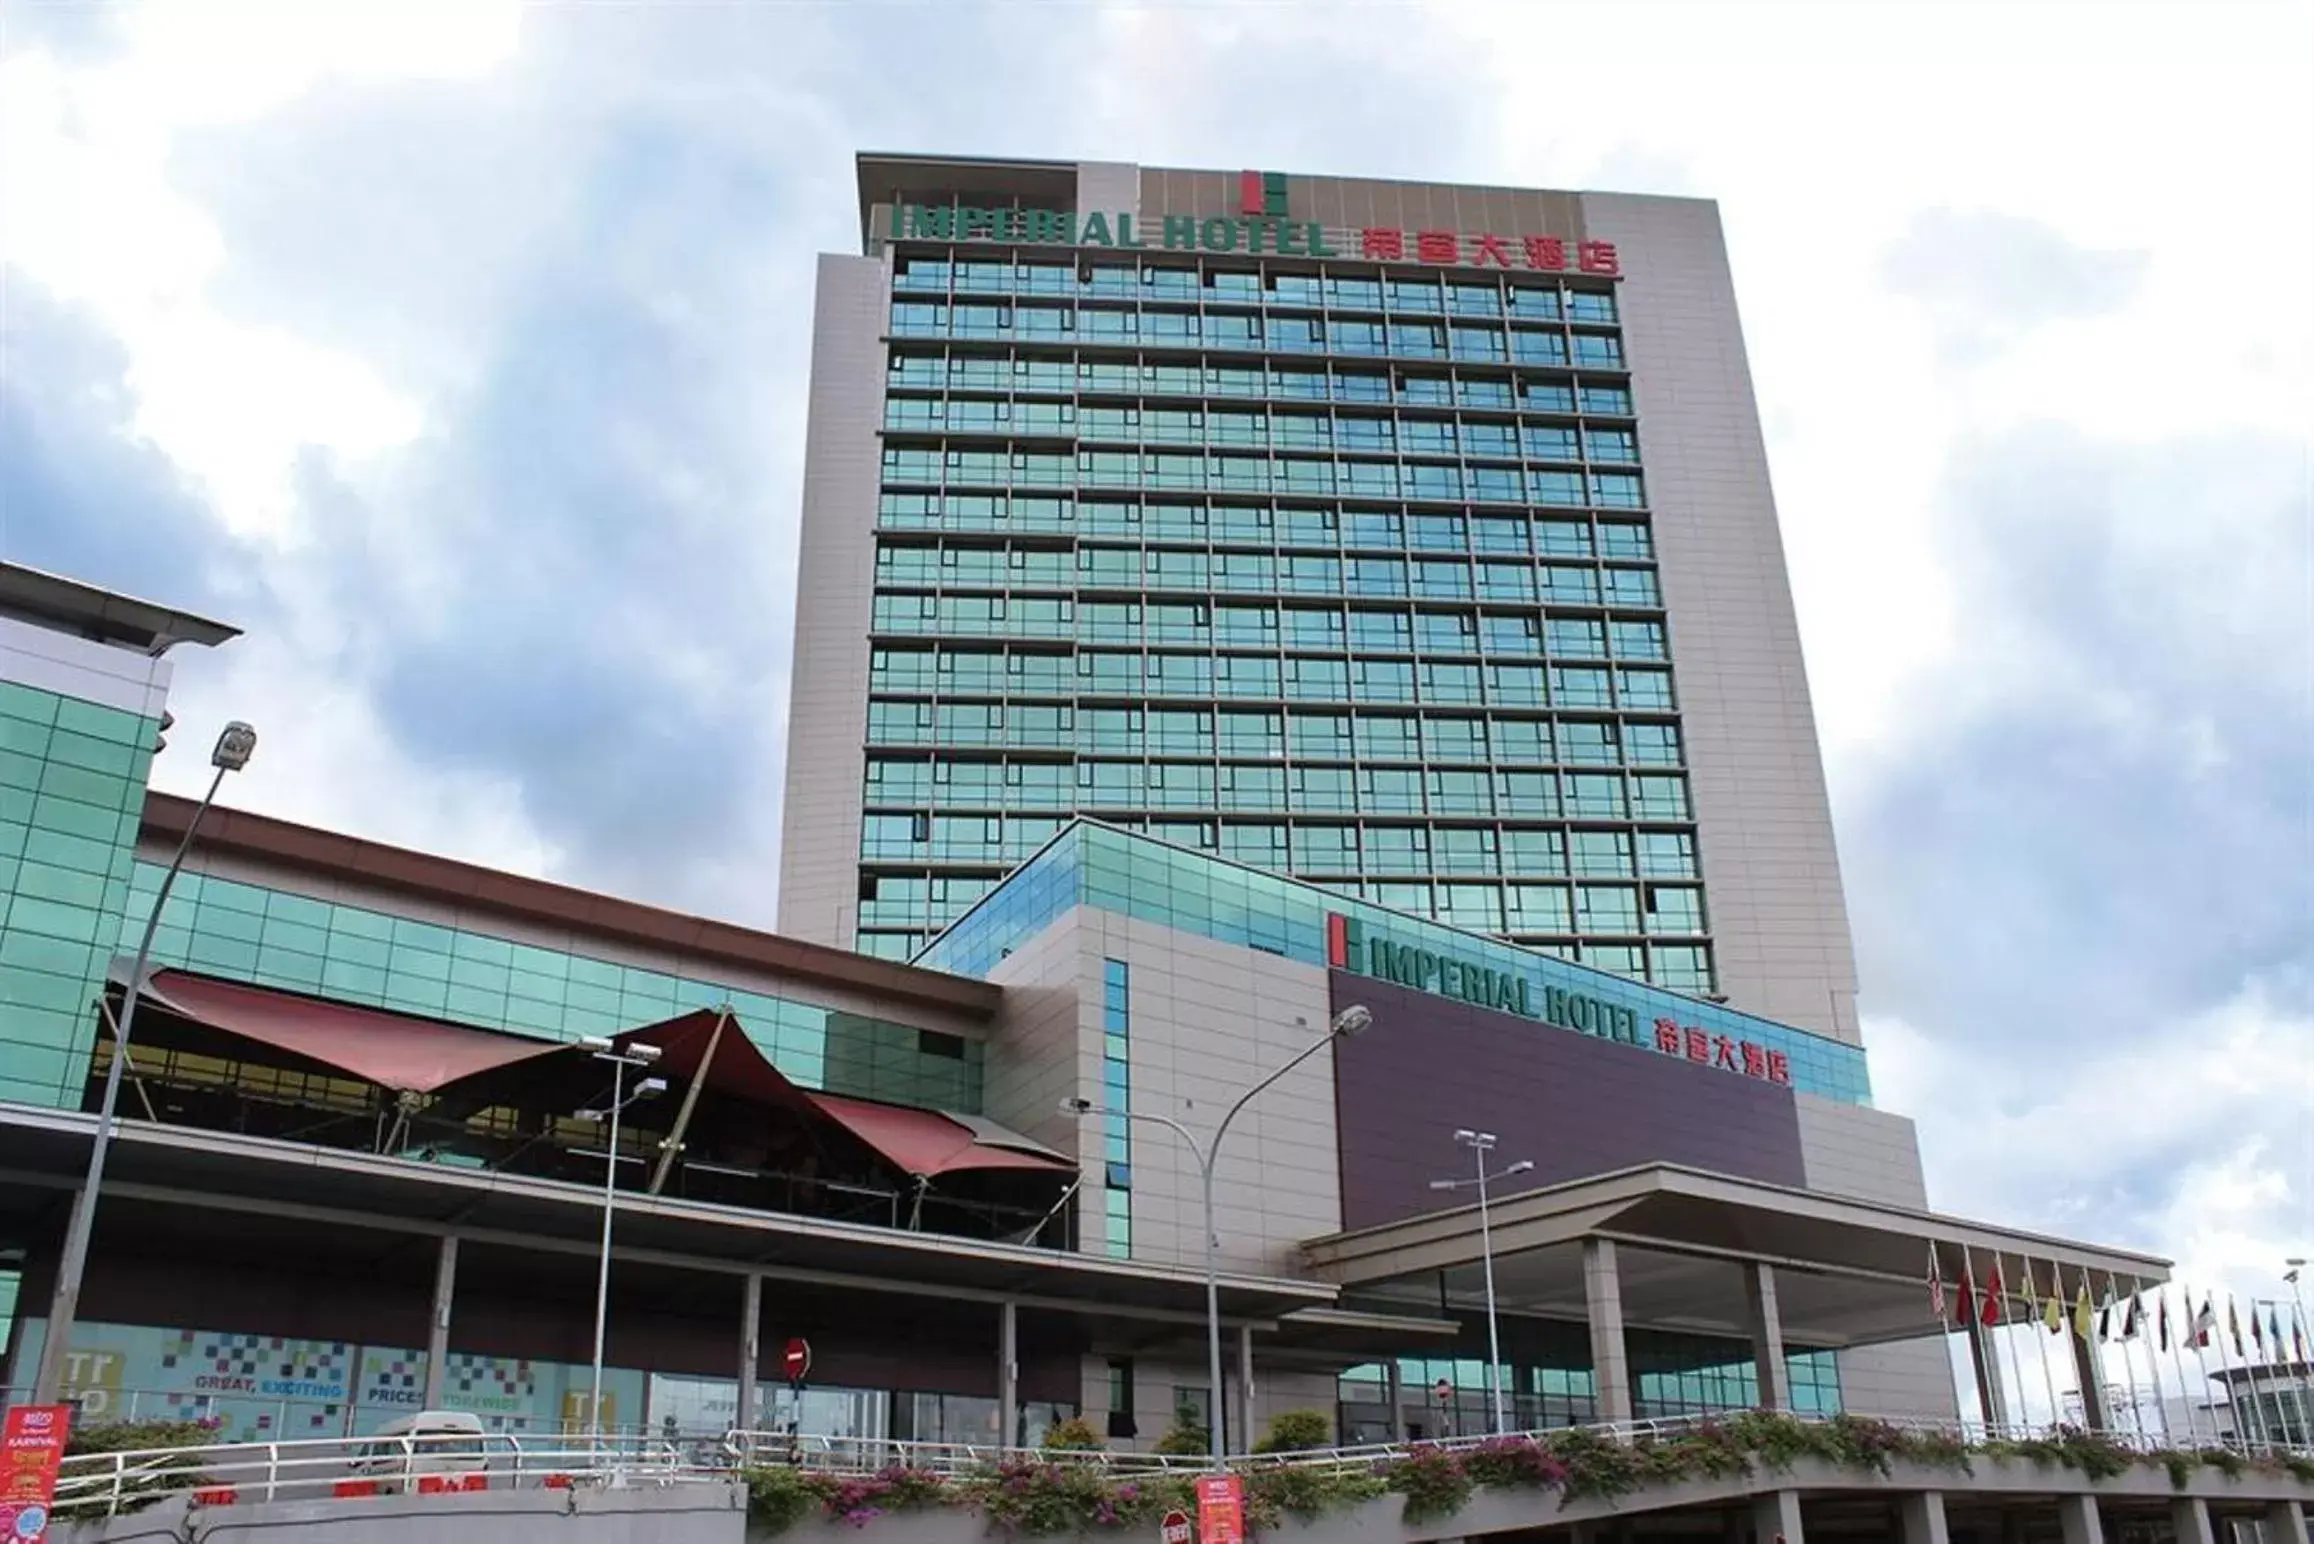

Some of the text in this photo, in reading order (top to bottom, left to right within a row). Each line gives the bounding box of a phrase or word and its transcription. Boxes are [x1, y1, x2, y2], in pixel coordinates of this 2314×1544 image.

[892, 203, 1337, 256] IMPERIAL HOTEL
[1370, 936, 1650, 1048] IMPERIAL HOTEL
[262, 1379, 342, 1397] EXCITING
